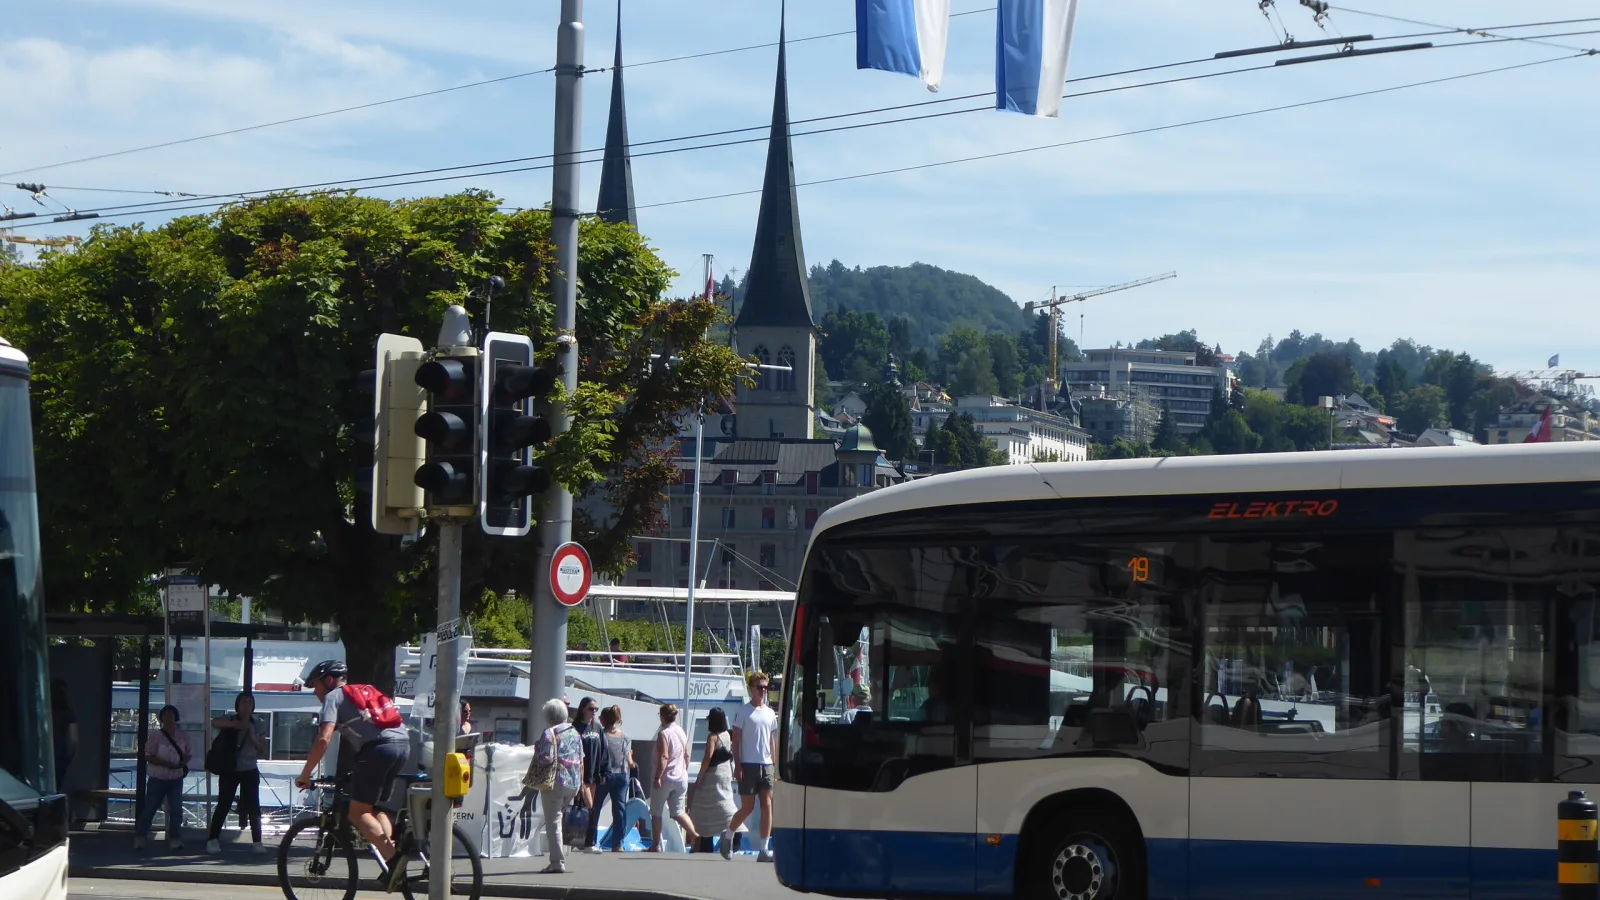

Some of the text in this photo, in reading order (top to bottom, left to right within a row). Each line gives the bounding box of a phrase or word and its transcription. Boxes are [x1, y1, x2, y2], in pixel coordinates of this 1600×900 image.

[1207, 500, 1338, 519] ELEKTRO
[1127, 557, 1149, 581] 19
[394, 680, 408, 695] NG
[453, 812, 474, 820] ZERN
